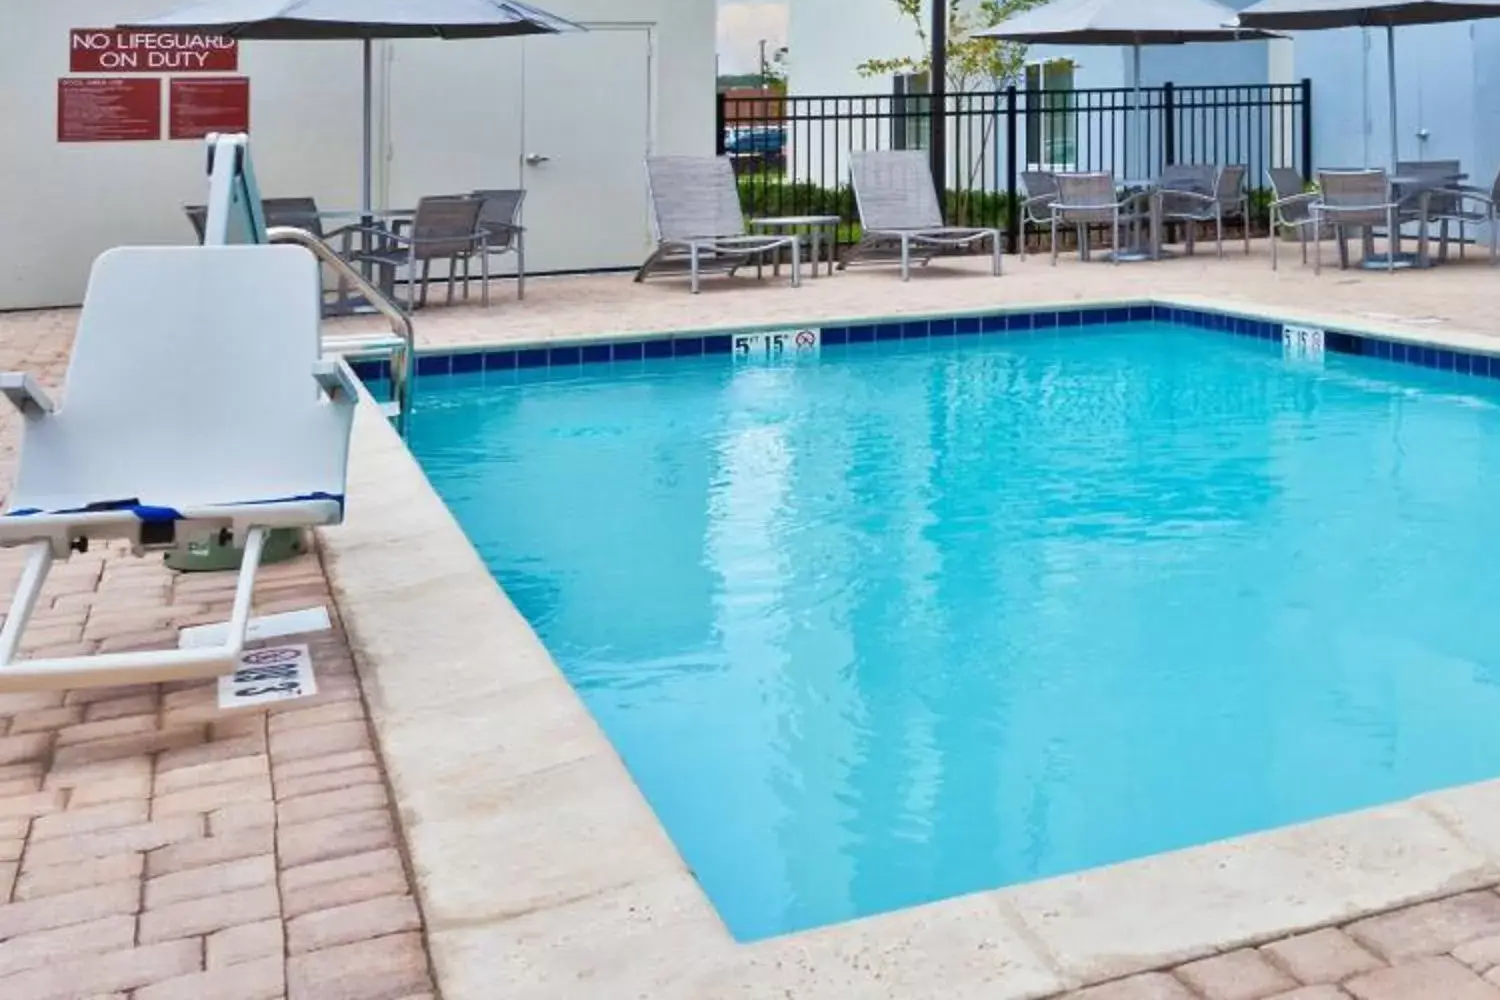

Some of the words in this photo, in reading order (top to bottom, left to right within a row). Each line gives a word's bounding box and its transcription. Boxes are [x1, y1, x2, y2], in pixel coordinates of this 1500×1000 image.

[73, 34, 110, 49] NO
[117, 33, 236, 49] LIFEGUARD
[99, 51, 137, 67] ON
[148, 51, 210, 67] DUTY
[735, 337, 750, 355] 5
